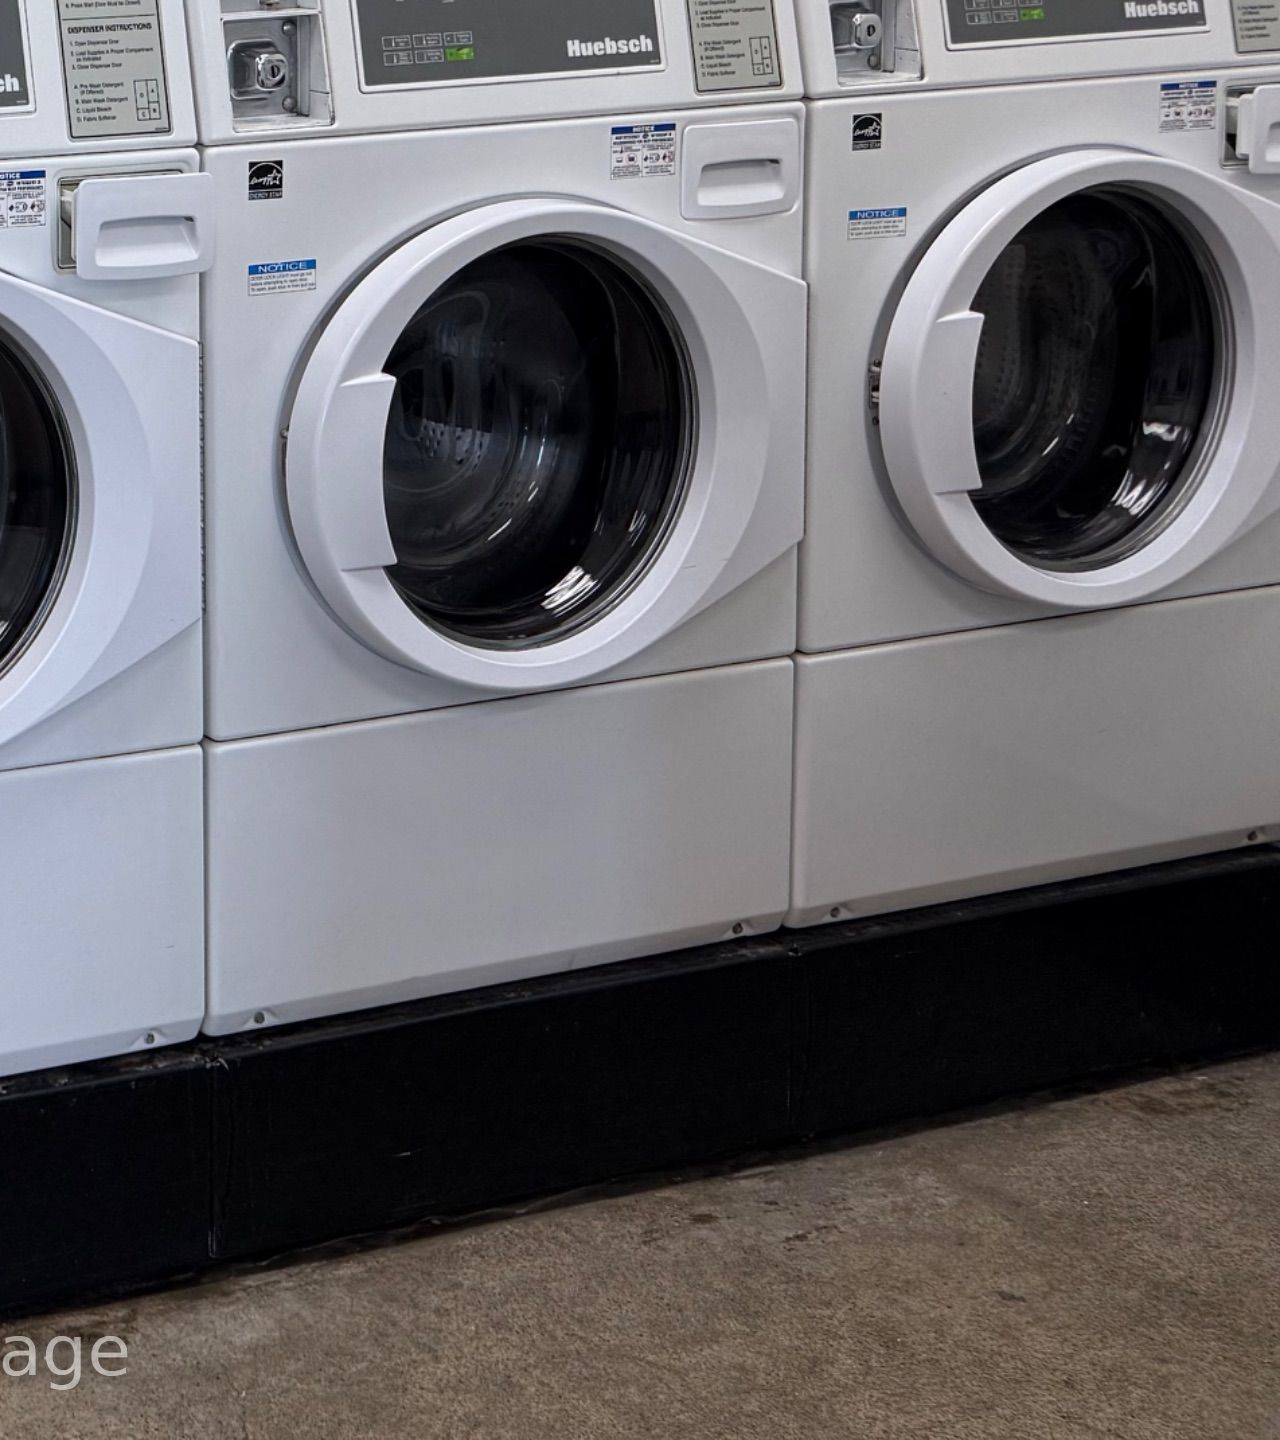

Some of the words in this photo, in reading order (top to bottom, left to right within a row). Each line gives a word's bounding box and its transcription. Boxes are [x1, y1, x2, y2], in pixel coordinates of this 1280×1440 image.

[67, 25, 104, 34] DISPENSER
[105, 23, 152, 32] INSTRUCTIONS
[567, 35, 652, 57] Huebsch
[858, 210, 899, 219] NOTICE
[258, 262, 307, 274] NOTICE
